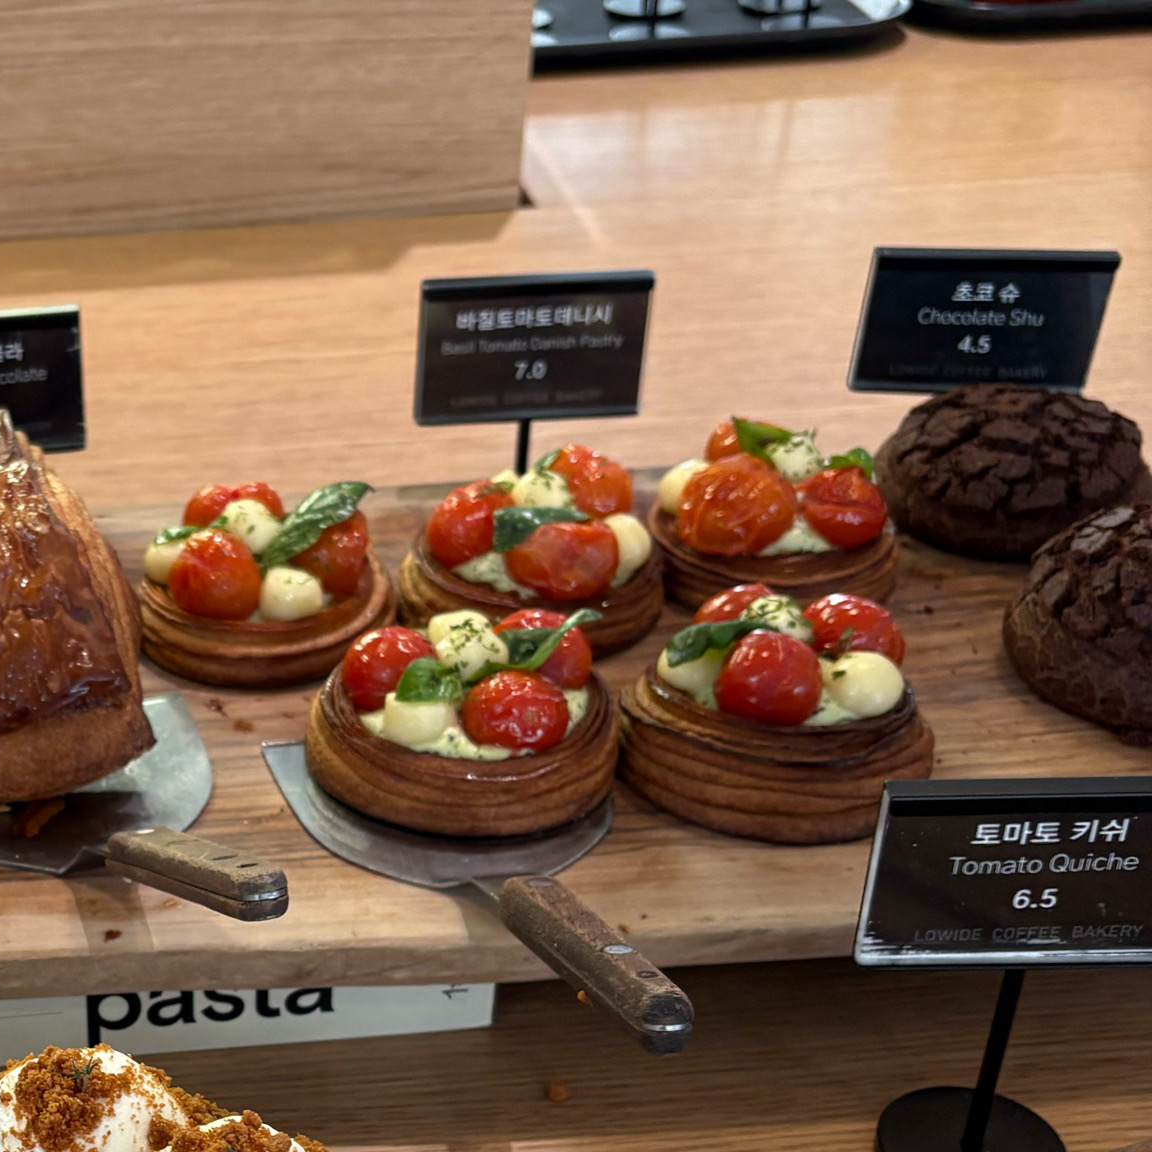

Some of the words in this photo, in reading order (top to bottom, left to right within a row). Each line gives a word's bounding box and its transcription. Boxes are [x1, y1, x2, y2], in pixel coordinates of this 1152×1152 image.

[951, 280, 995, 302] 초코
[998, 282, 1021, 304] 슈
[917, 306, 1006, 326] Chocolate
[1008, 306, 1045, 327] Shu
[957, 333, 992, 354] 4.5
[514, 358, 547, 381] 7.0
[970, 821, 1062, 846] 토마토
[1069, 818, 1131, 843] 키쉬
[949, 855, 1044, 876] Tomato
[1048, 851, 1141, 874] Quiche
[1011, 887, 1059, 910] 6.5
[913, 927, 984, 943] LOWIDE
[991, 924, 1062, 942] COFFEE
[1071, 922, 1145, 940] BAKERY
[86, 987, 336, 1048] pasta
